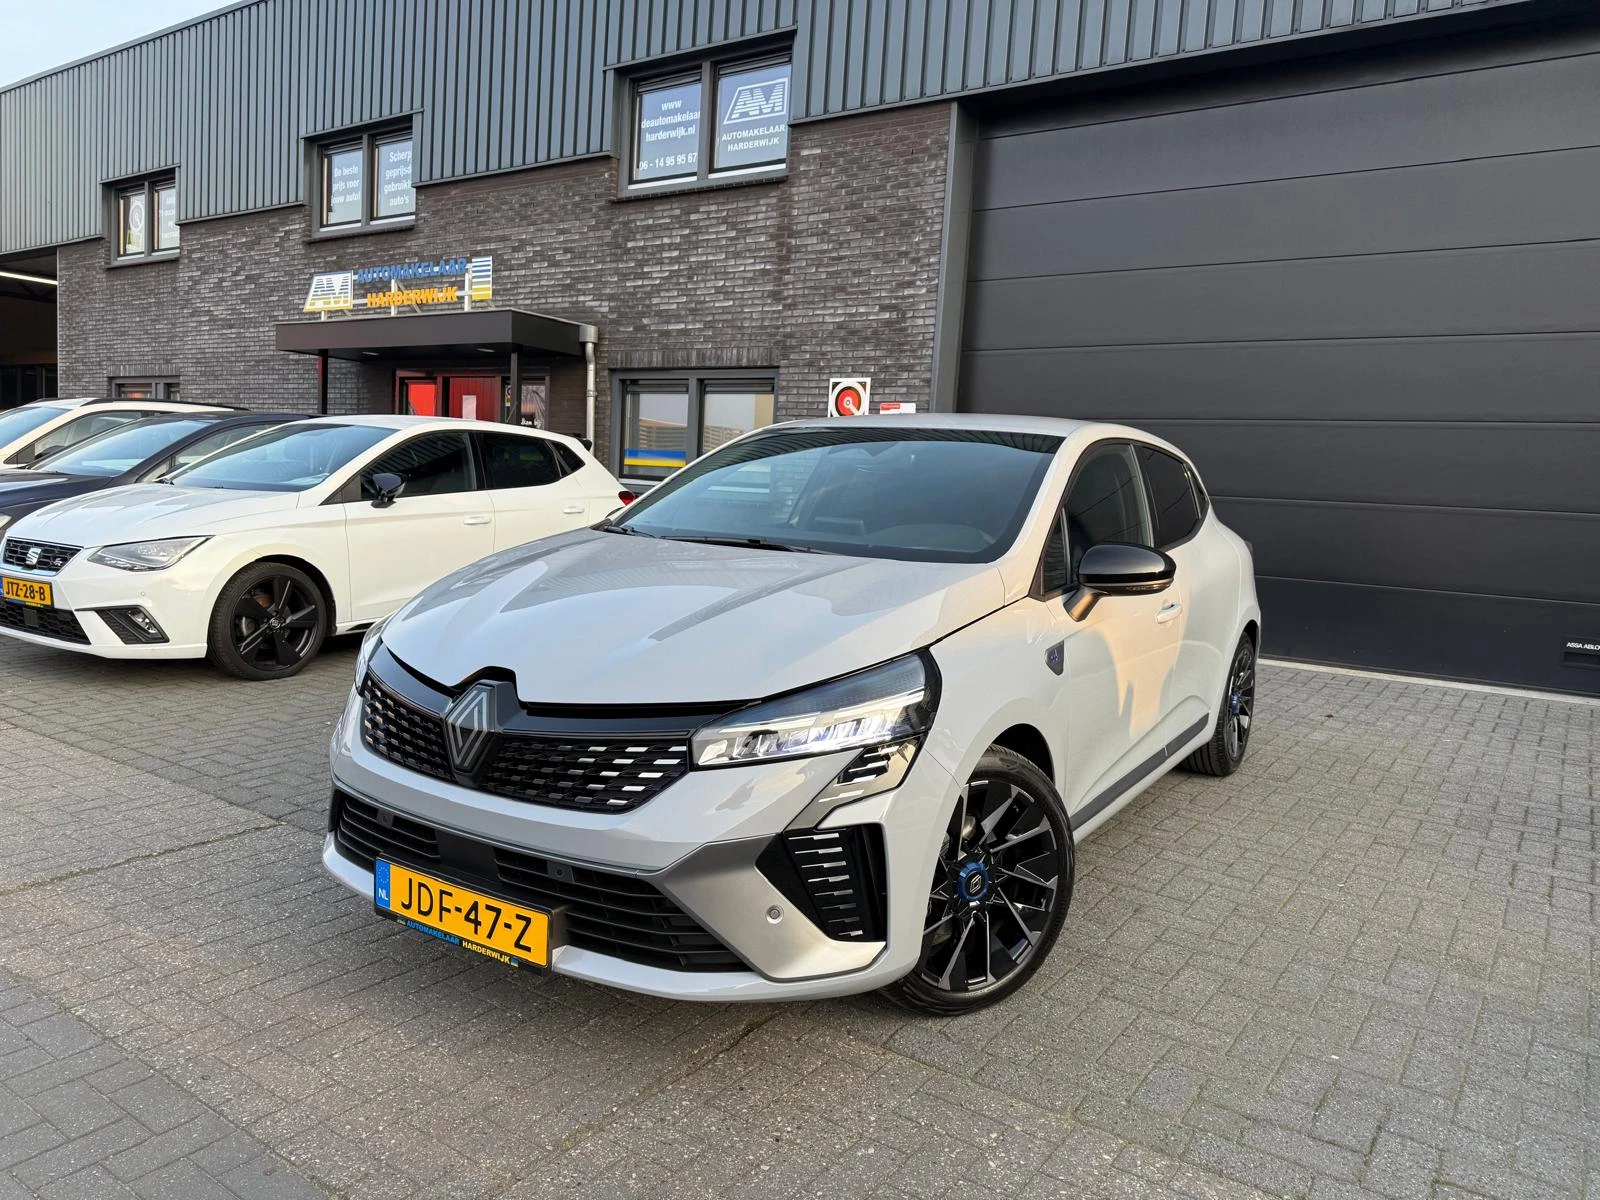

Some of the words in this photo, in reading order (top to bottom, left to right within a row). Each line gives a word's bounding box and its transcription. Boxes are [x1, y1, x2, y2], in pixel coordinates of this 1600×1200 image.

[661, 99, 682, 111] www
[645, 125, 695, 142] harderwijk.nl
[721, 123, 785, 141] AUTOMAKELAAR
[727, 136, 780, 152] HARDERWIJK
[389, 150, 412, 163] Scherp
[639, 159, 649, 171] 06
[655, 157, 664, 169] 14
[665, 155, 675, 167] 95
[676, 154, 686, 166] 95
[688, 152, 698, 164] 67
[342, 165, 359, 177] beste
[356, 258, 468, 283] AUTOMAKELAAR
[366, 287, 458, 308] HARDERWIJK
[5, 581, 46, 601] JTZ-28-B
[378, 888, 389, 901] NL
[400, 877, 532, 953] JDF-47-Z
[406, 919, 460, 946] AUTOMAKELAAR
[462, 940, 511, 965] HARDERWIJK
